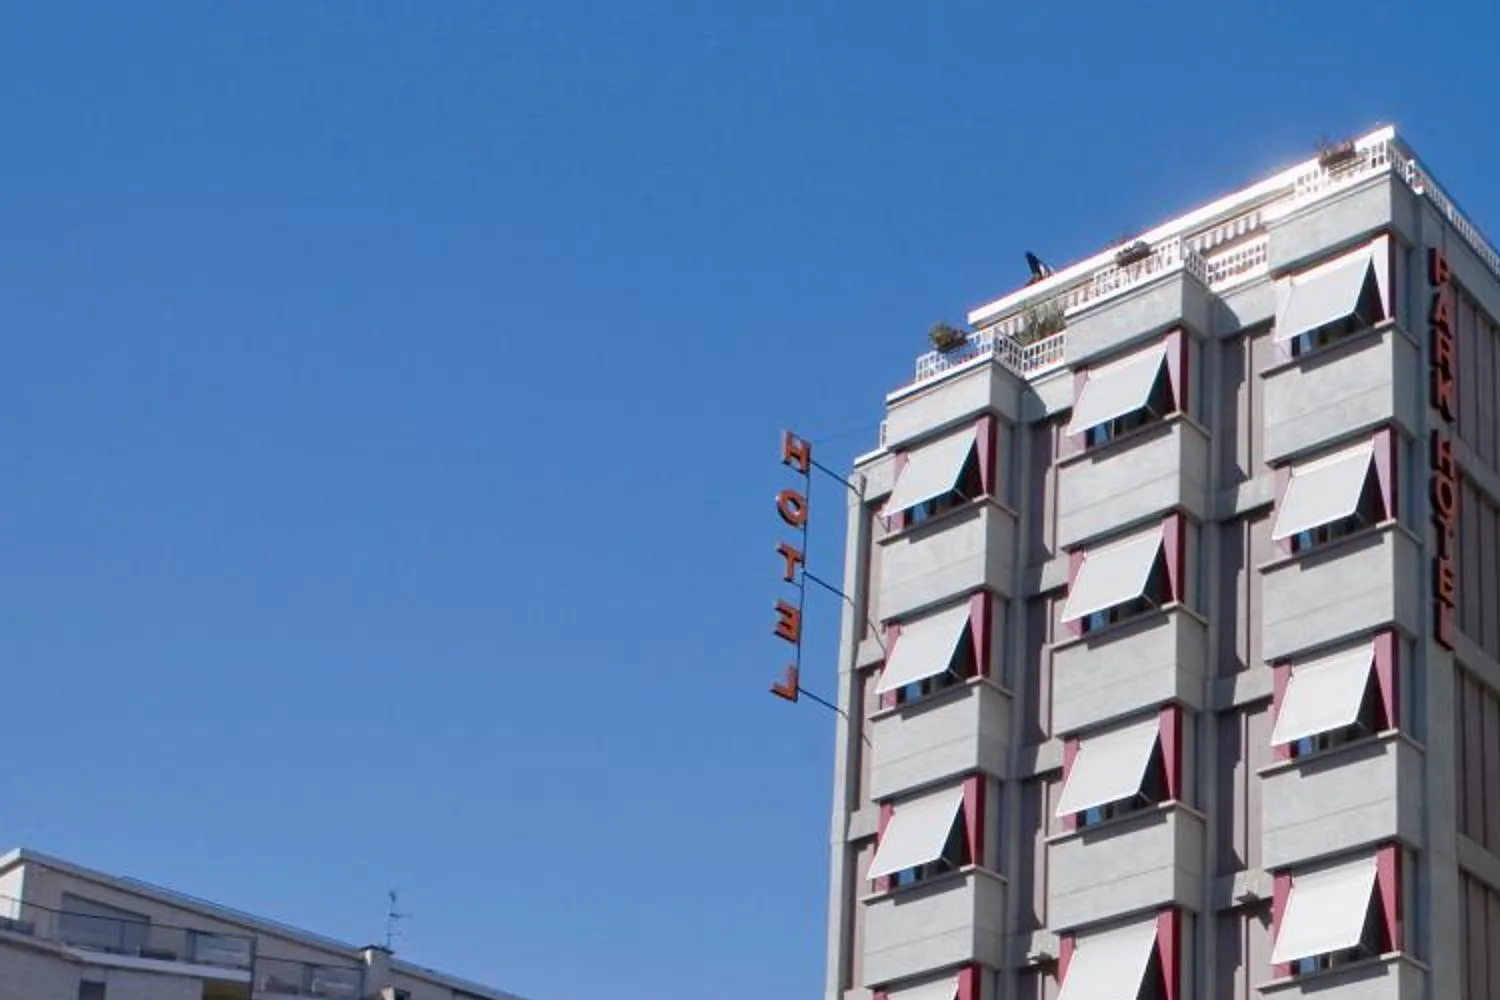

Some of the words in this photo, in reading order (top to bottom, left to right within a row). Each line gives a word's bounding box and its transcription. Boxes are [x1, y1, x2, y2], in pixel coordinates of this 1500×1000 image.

[1428, 247, 1455, 423] PARK
[771, 430, 811, 703] HOTEL
[1430, 429, 1458, 651] HOTEL
